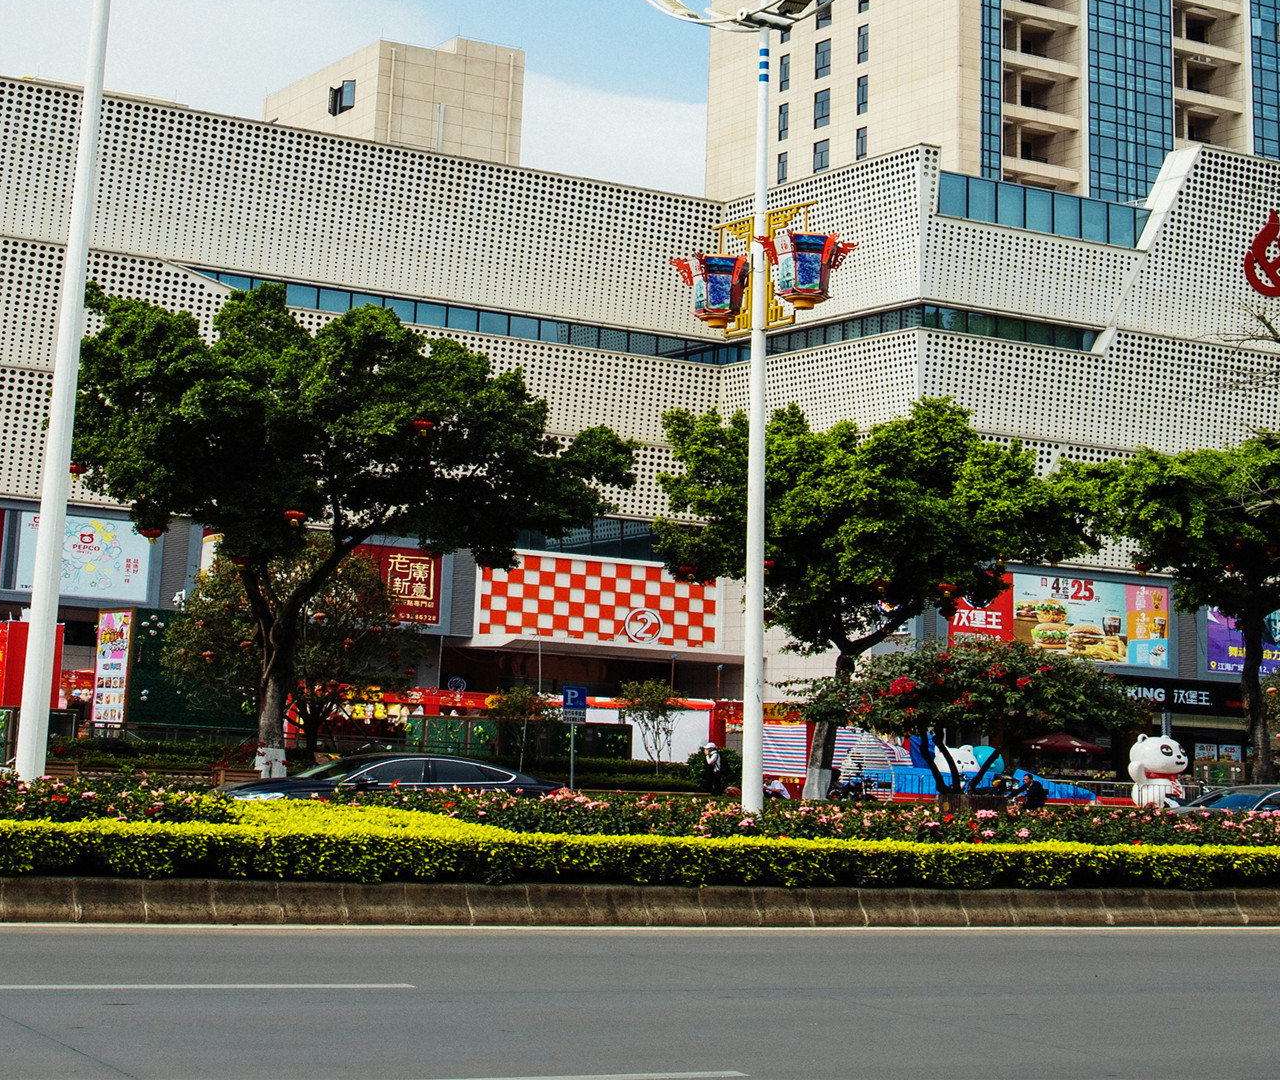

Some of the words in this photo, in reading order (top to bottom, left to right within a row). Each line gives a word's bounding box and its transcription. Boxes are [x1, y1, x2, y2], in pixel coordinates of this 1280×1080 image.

[72, 543, 101, 552] PEPCO
[953, 609, 1002, 629] 汉堡王
[566, 689, 579, 705] P
[1173, 689, 1210, 705] 汉堡王
